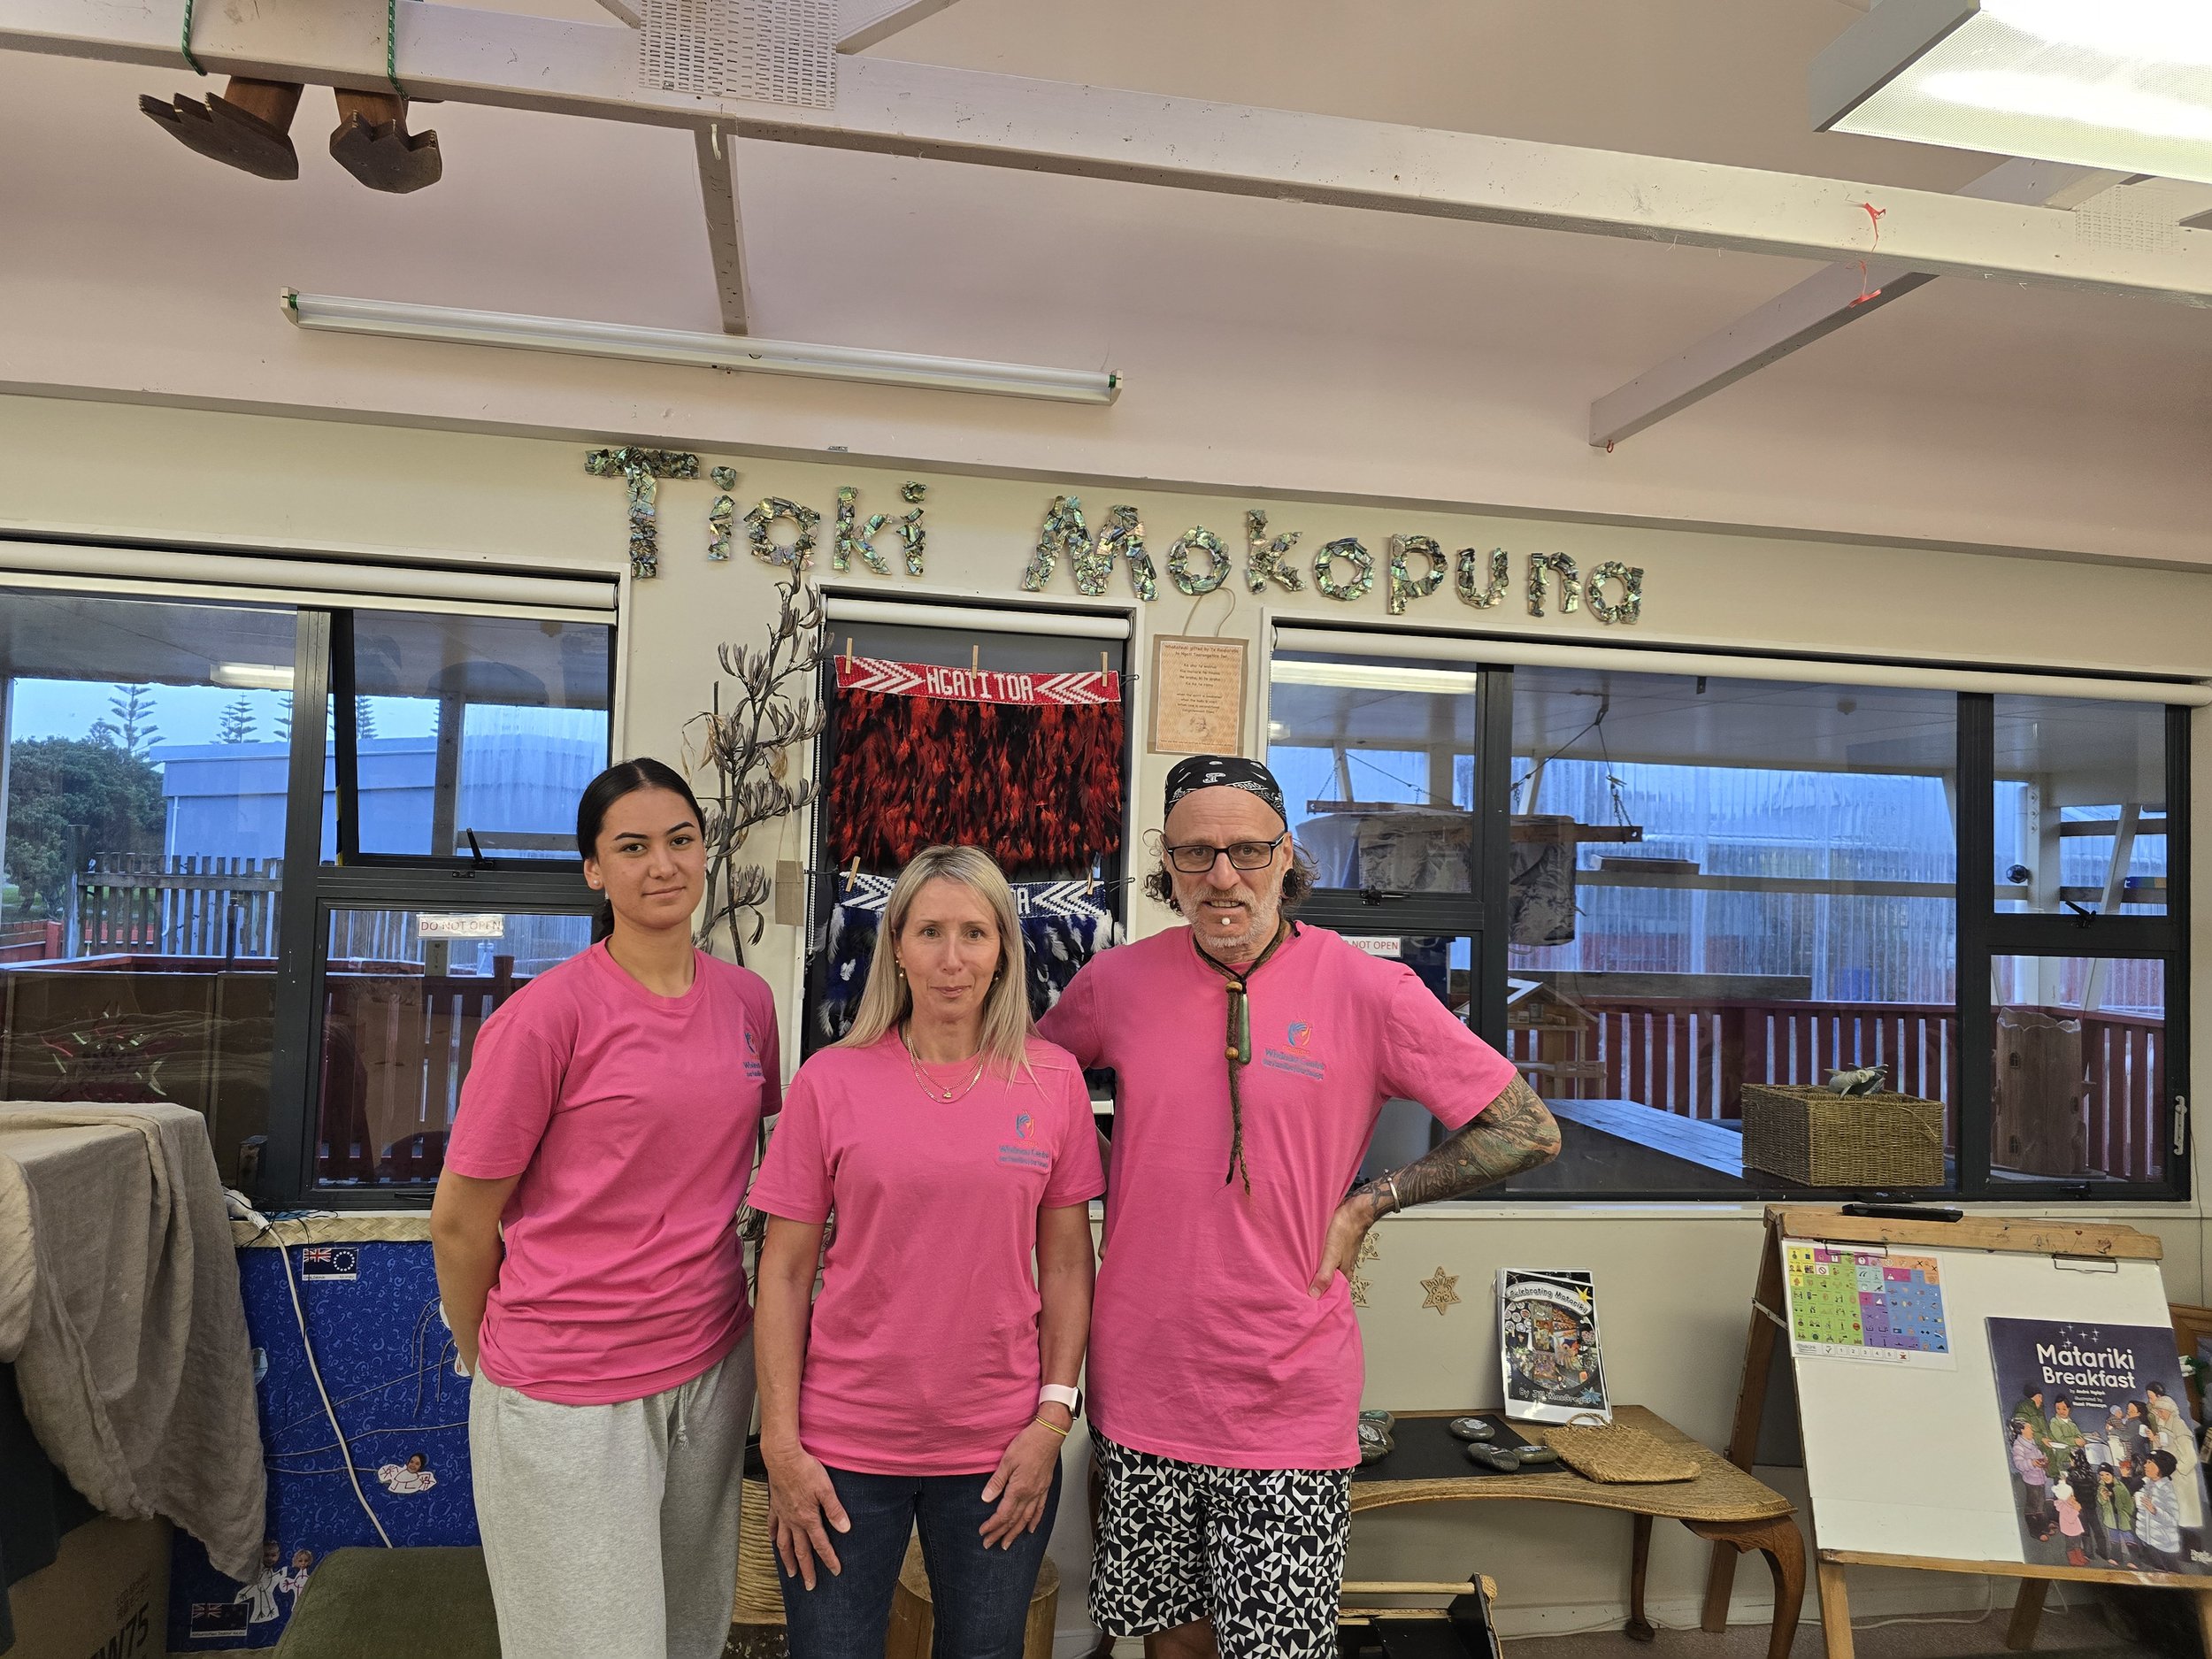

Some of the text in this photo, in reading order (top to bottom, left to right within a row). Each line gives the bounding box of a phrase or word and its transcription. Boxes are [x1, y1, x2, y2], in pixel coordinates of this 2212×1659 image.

[1023, 495, 1644, 625] Mokopuna
[995, 674, 1033, 701] TOA
[421, 920, 501, 931] DO NOT OPEN
[1352, 941, 1371, 949] NOT
[2036, 1343, 2135, 1370] Matariki
[2043, 1369, 2136, 1389] Breakfast
[1519, 1386, 1530, 1398] By
